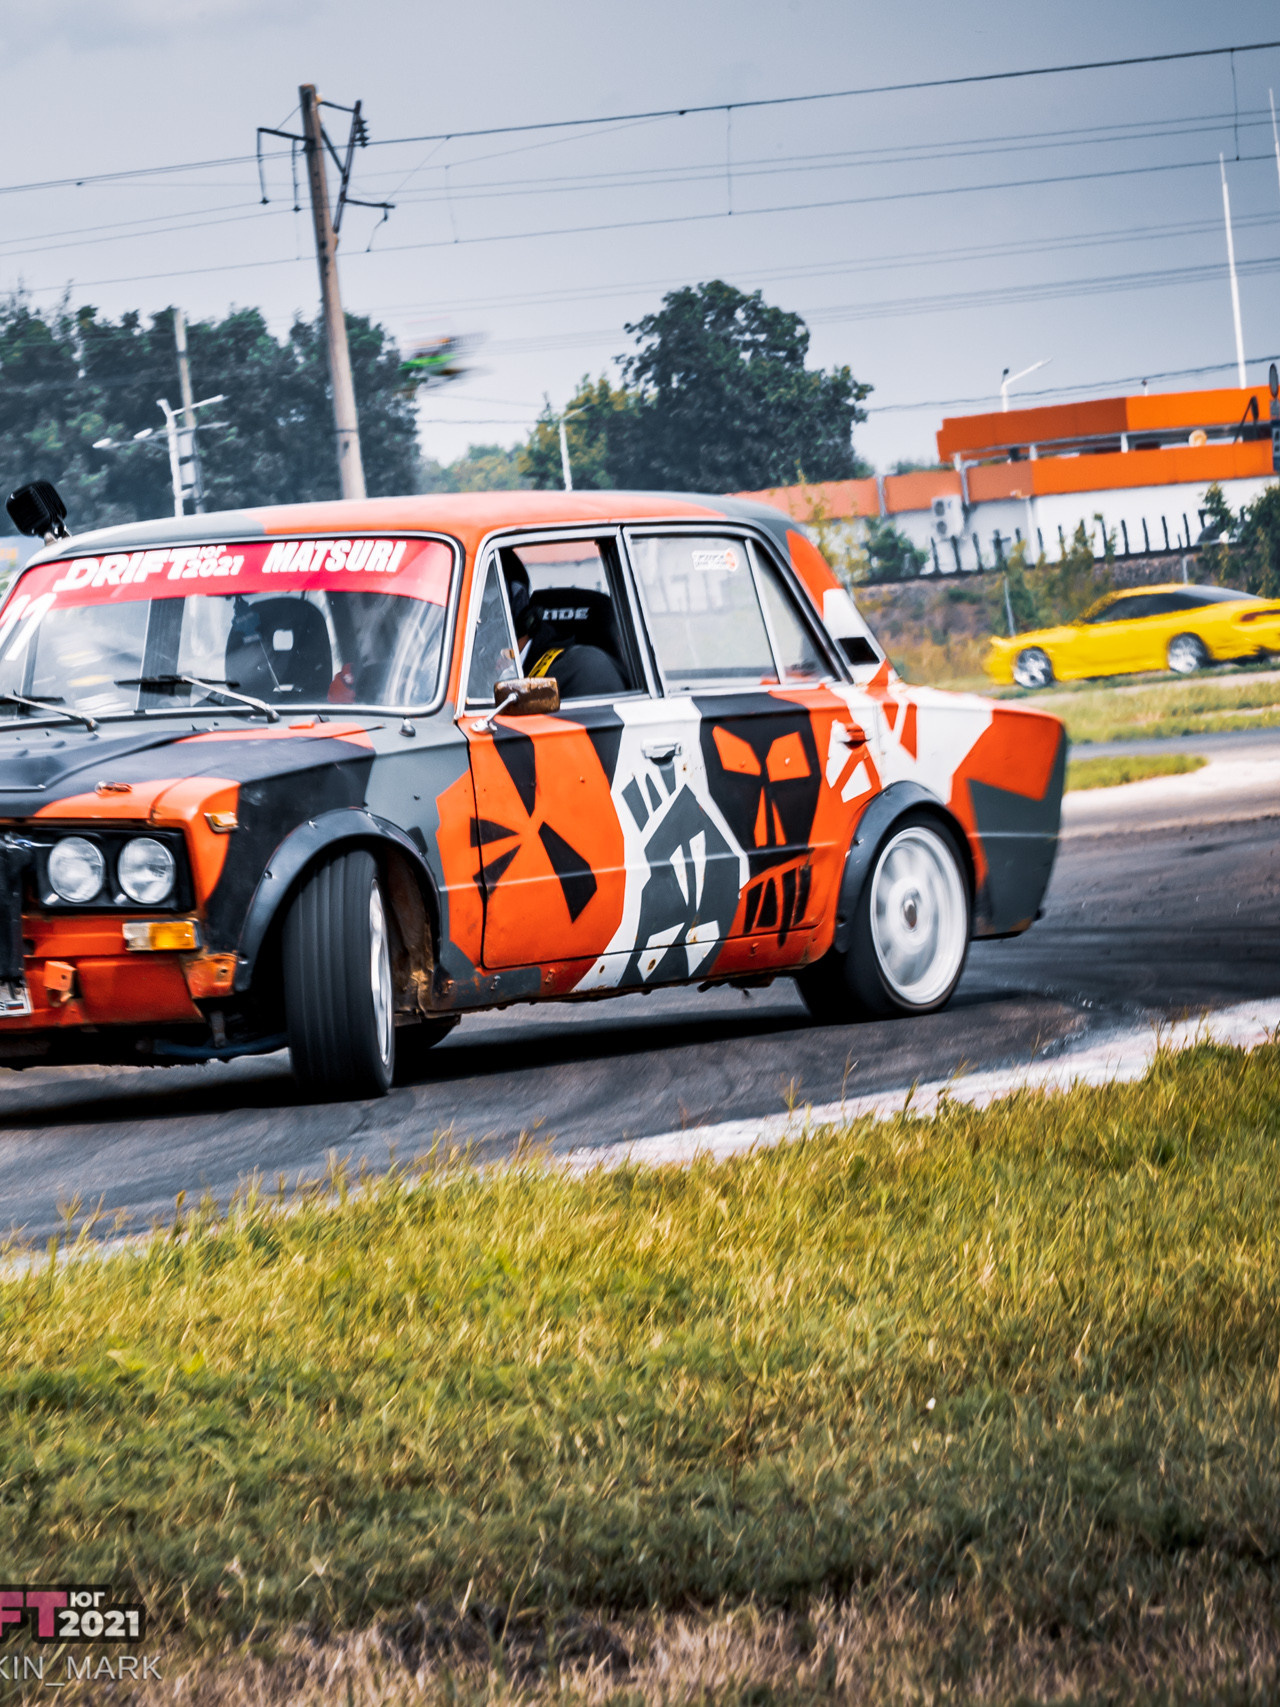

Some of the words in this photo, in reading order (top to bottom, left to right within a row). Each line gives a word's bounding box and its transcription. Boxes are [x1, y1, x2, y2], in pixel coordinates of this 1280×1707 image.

[52, 548, 201, 593] DRIFT
[181, 555, 245, 579] 2021
[261, 540, 407, 573] MATSURI
